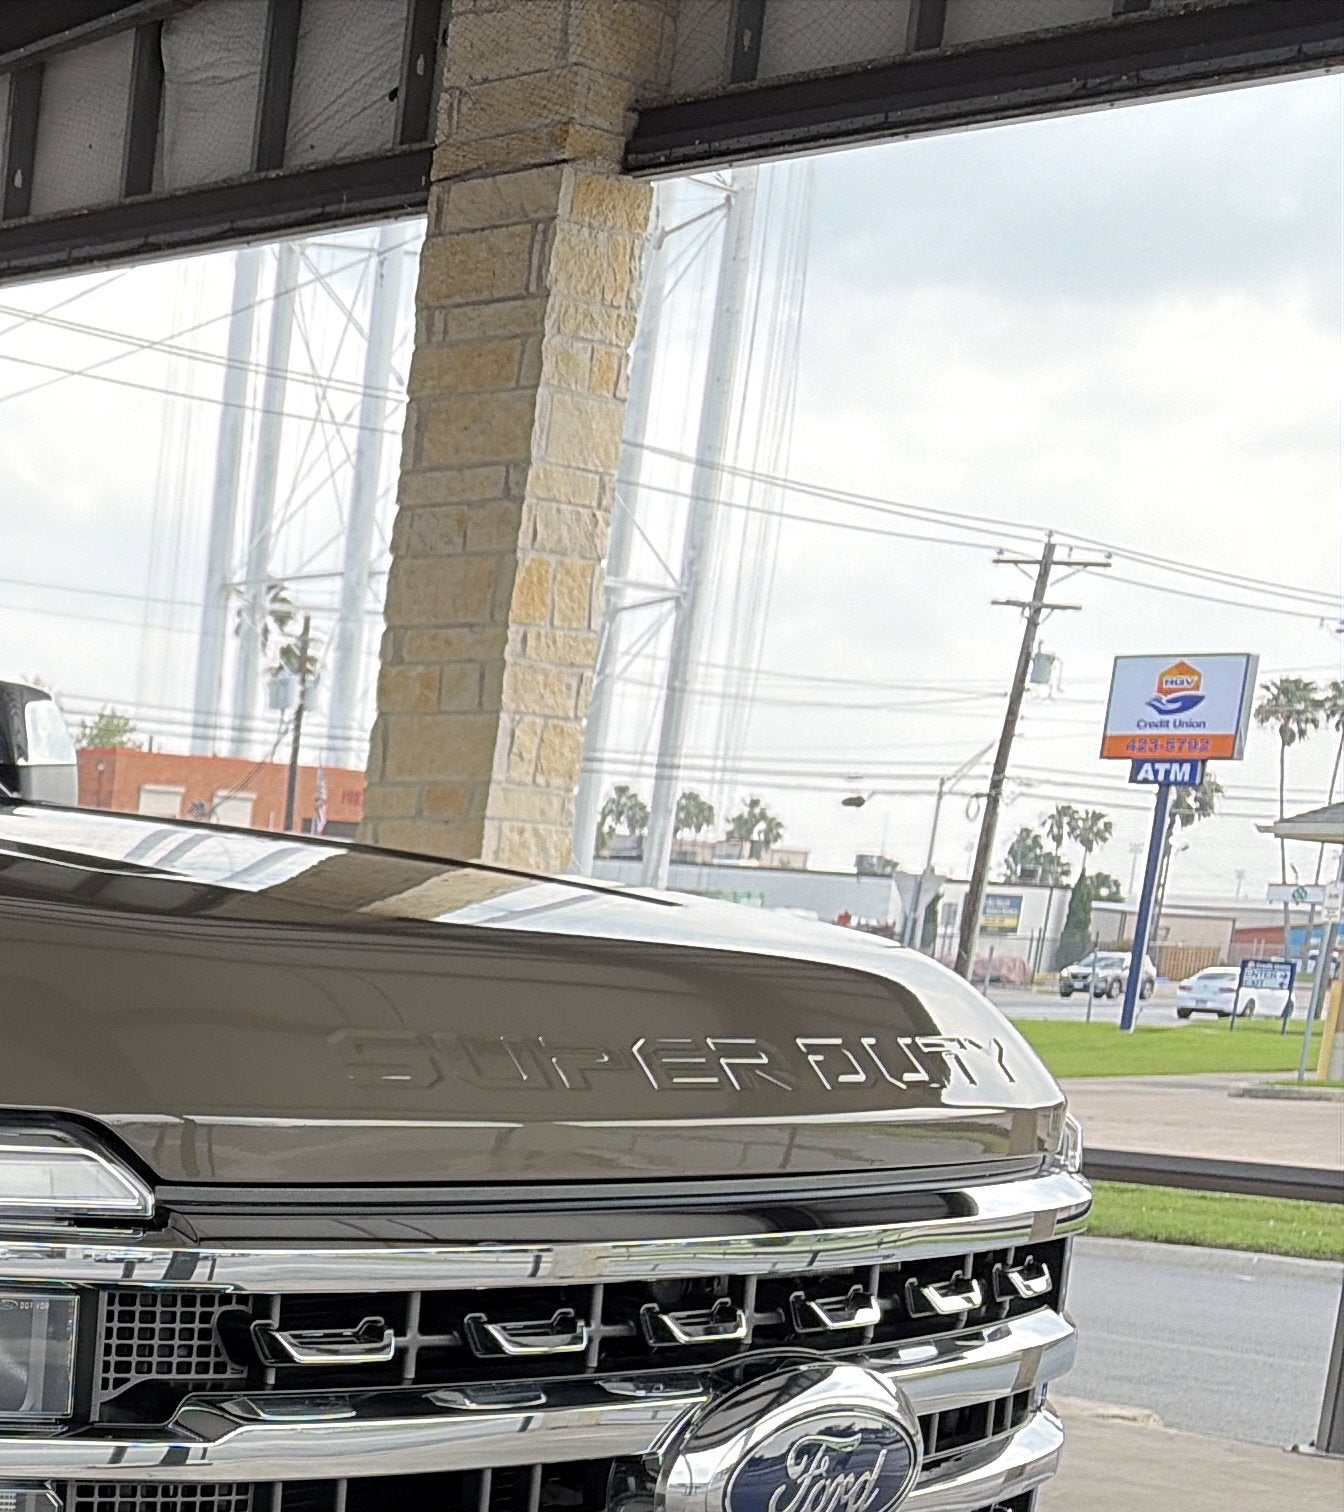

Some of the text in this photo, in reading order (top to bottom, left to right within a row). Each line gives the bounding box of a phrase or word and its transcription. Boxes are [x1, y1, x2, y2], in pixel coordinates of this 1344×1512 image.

[1136, 718, 1207, 730] Credit Union
[1136, 762, 1192, 783] ATM
[327, 1026, 1018, 1091] SUPER DUTY
